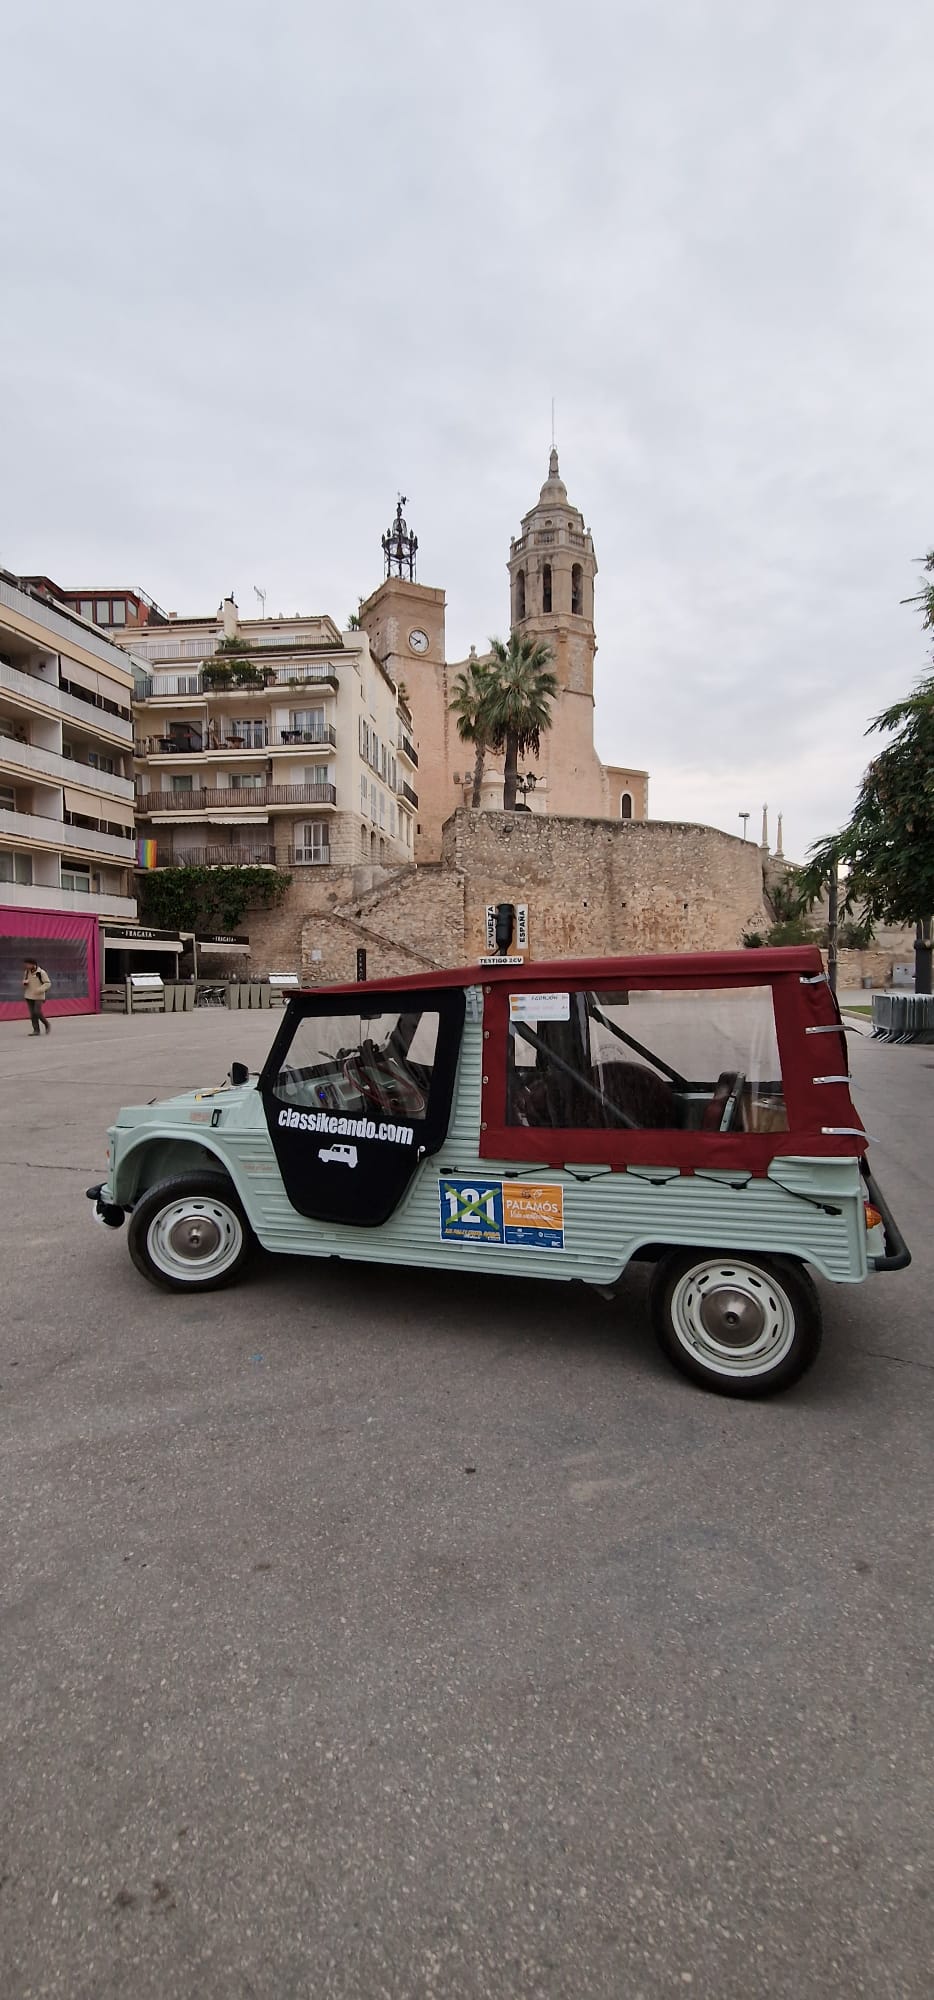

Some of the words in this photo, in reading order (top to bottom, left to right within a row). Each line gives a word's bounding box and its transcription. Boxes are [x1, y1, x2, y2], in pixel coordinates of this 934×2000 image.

[125, 930, 153, 938] FRAGATA
[518, 910, 526, 943] ESPAÑA
[278, 1107, 414, 1146] classikeando.com
[445, 1188, 496, 1224] 121
[506, 1199, 559, 1214] PALAMÓS
